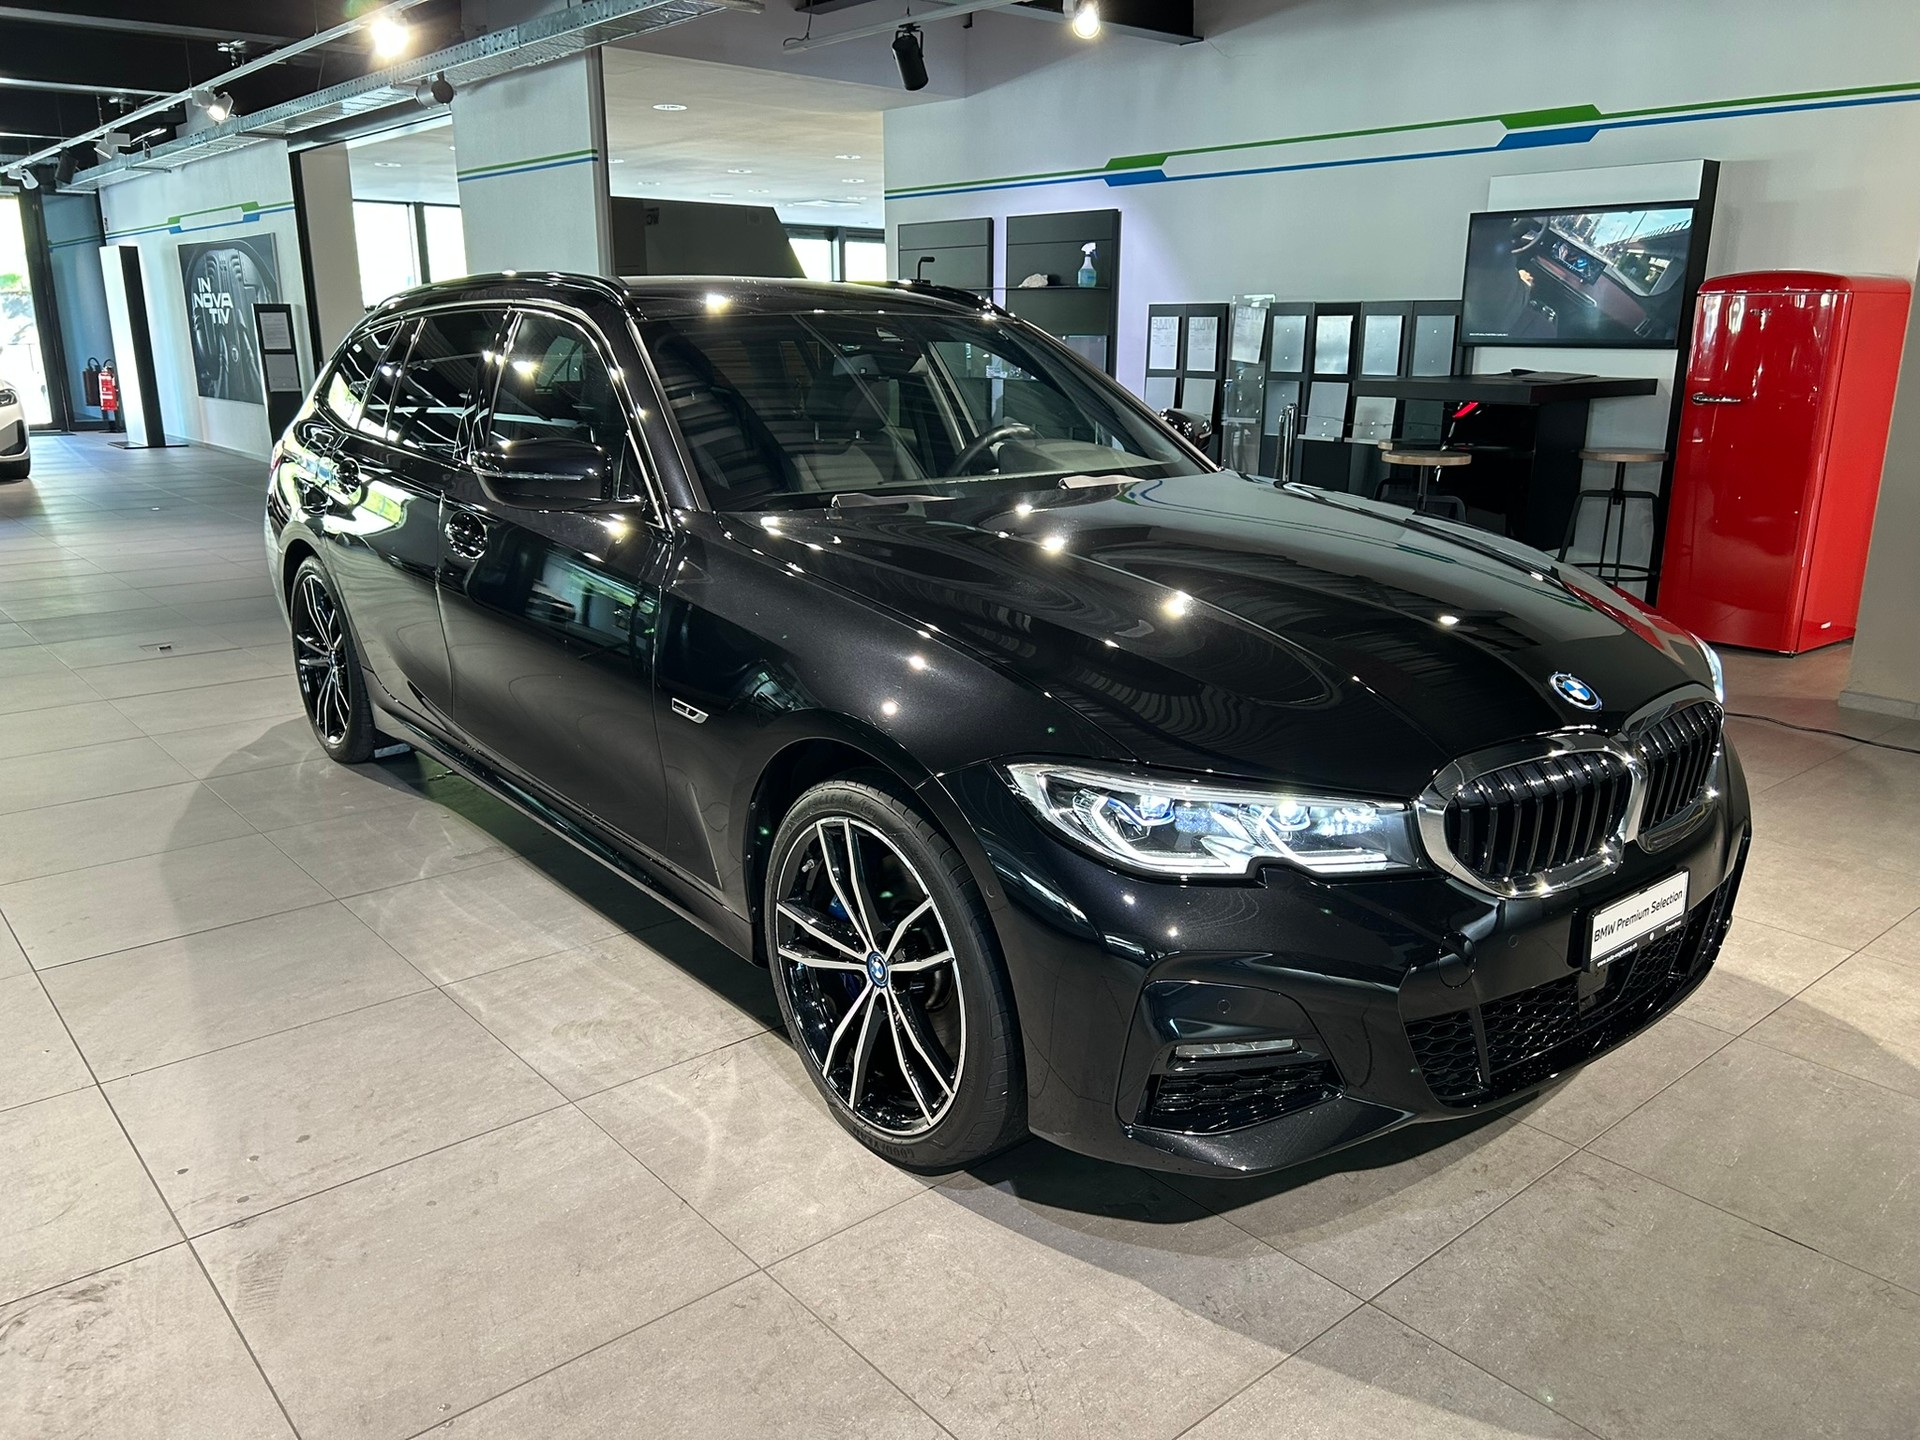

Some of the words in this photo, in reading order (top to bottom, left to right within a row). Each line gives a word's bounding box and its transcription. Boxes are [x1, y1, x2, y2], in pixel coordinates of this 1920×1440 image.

[197, 277, 211, 293] IN
[193, 292, 233, 308] NOVA
[209, 308, 230, 324] TIV
[1152, 318, 1177, 330] BMW
[1189, 318, 1215, 330] BMW
[1594, 921, 1616, 942] BMW
[1616, 908, 1650, 931] Premium
[1651, 890, 1683, 914] Selection
